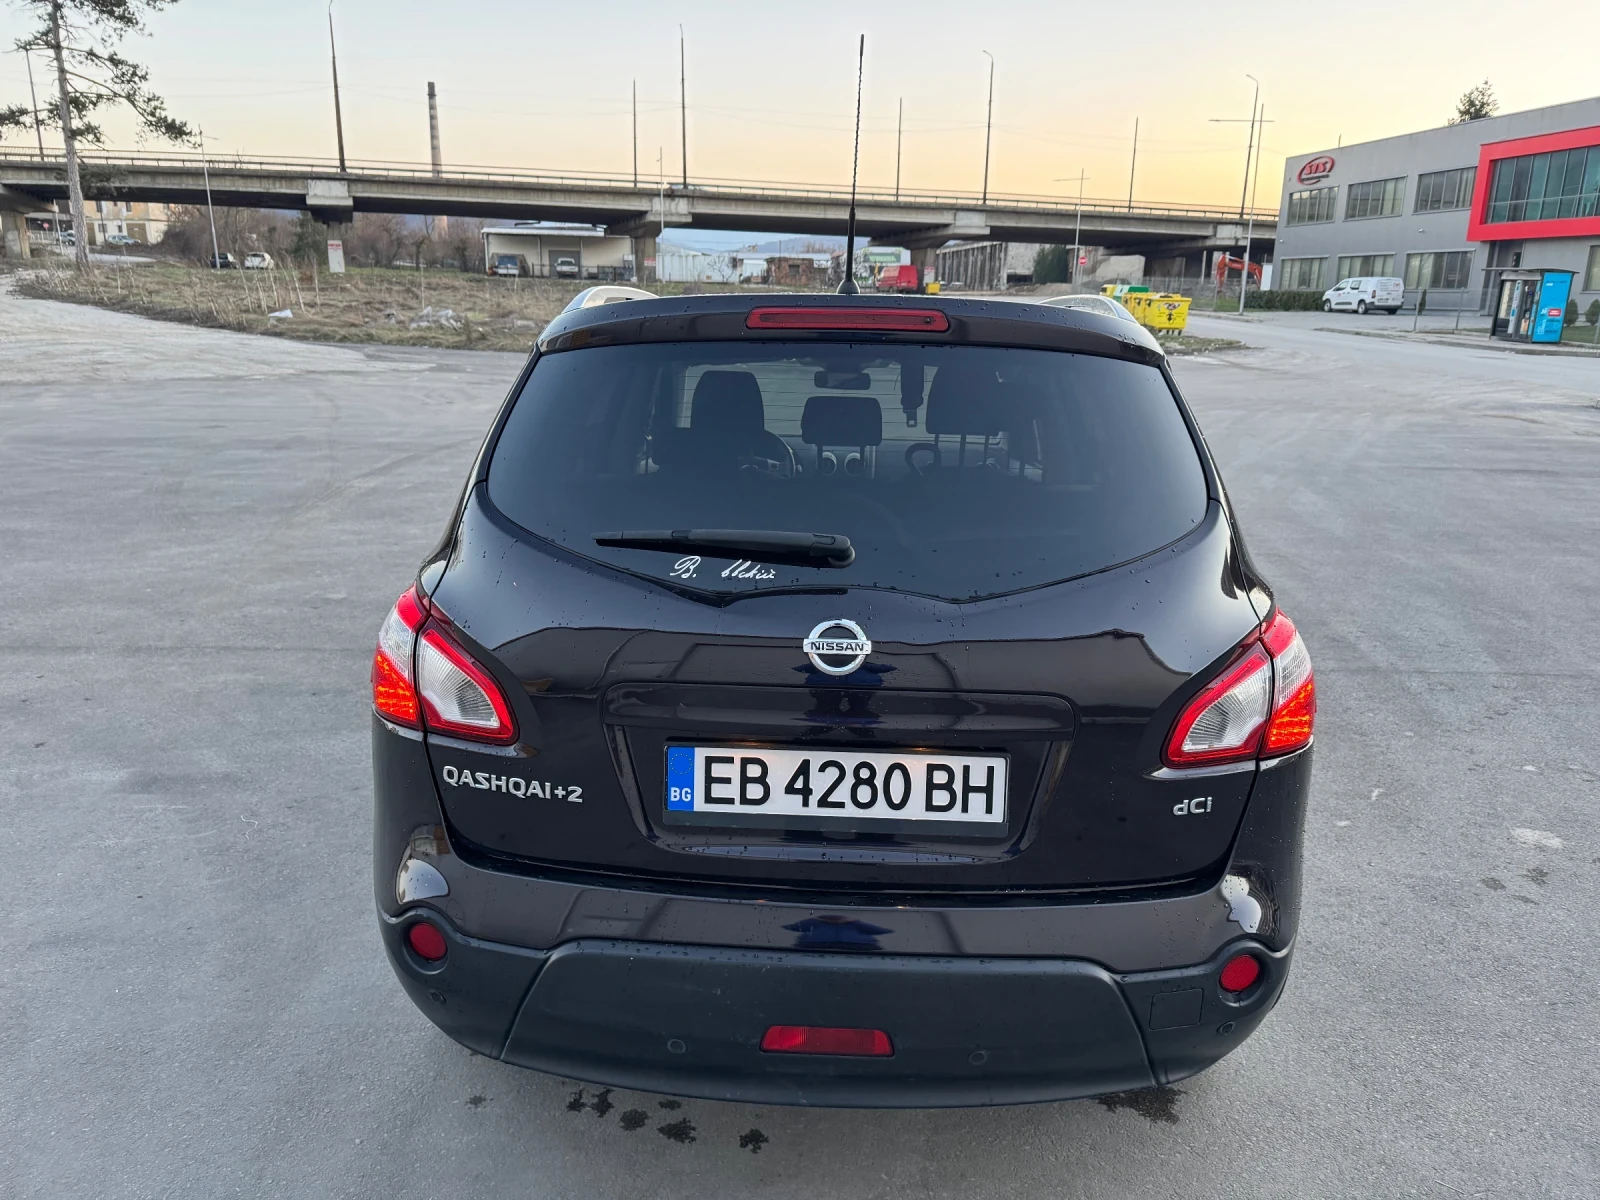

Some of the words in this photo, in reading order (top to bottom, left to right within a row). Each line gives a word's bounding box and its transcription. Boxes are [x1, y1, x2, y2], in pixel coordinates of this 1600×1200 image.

[810, 641, 865, 652] NISSAN
[442, 765, 583, 803] QASHQAI+2
[704, 755, 771, 806] EB
[784, 758, 912, 811] 4280
[925, 763, 995, 815] BH
[670, 787, 692, 802] BG
[1173, 796, 1213, 816] dCi
